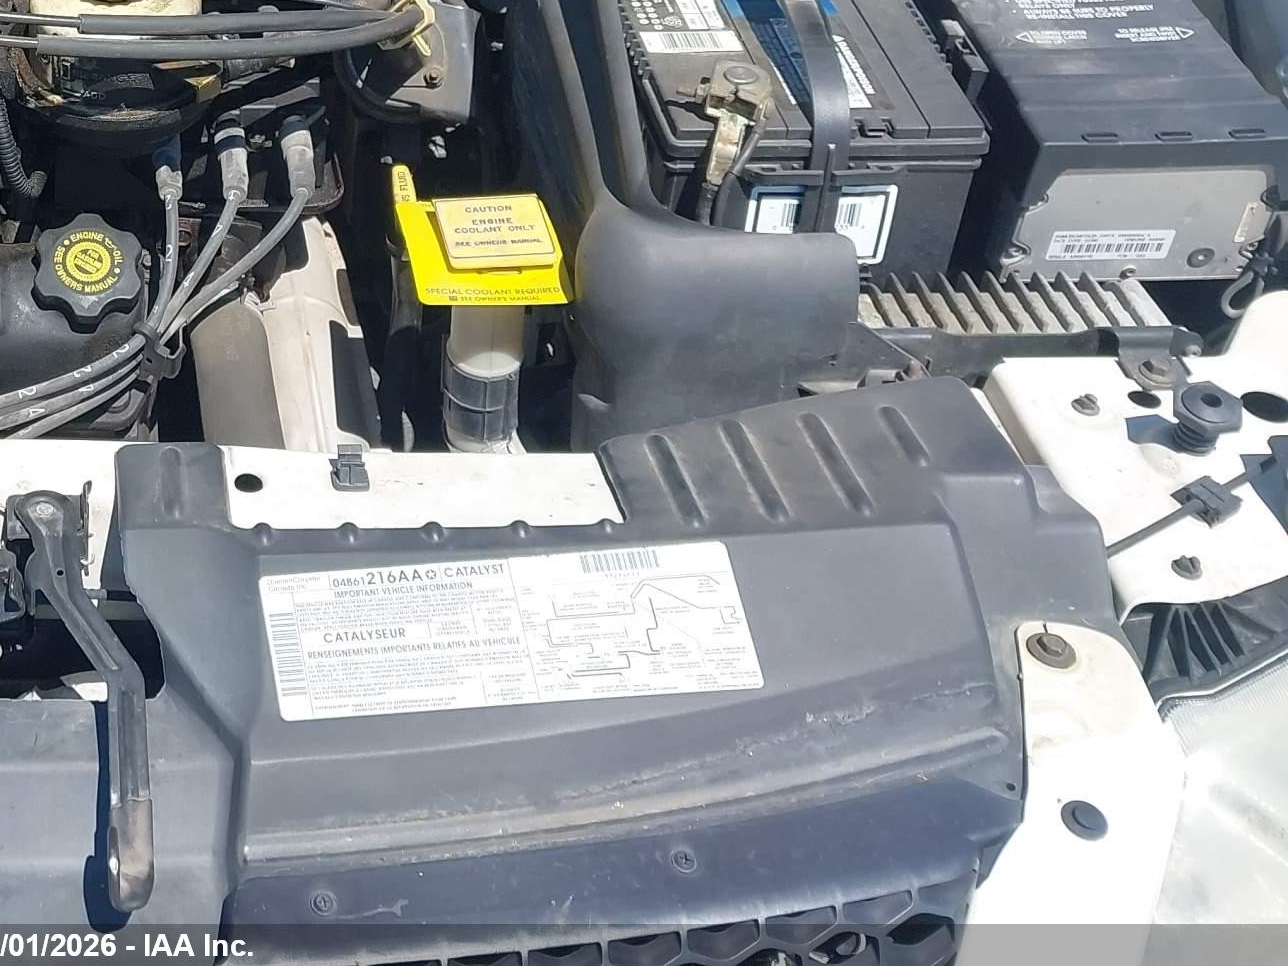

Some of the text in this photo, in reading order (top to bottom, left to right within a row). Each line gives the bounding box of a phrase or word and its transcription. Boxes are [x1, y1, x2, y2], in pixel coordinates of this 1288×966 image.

[83, 90, 106, 100] ADD
[465, 205, 512, 213] CAUTION
[455, 226, 502, 234] COOLANT
[70, 232, 123, 265] ENGINE OIL
[165, 244, 173, 262] 2
[54, 246, 118, 293] SEE OWNERS MANUAL
[444, 564, 504, 578] CATALYST
[333, 581, 473, 599] IMPORTANT VEHICLE INFORMATION
[323, 627, 406, 643] CATALYSEUR
[307, 647, 379, 660] RENSEIGNEMENTS
[381, 643, 431, 656] IMPORTANTS
[433, 640, 466, 650] RELATIFS
[469, 639, 480, 648] AU
